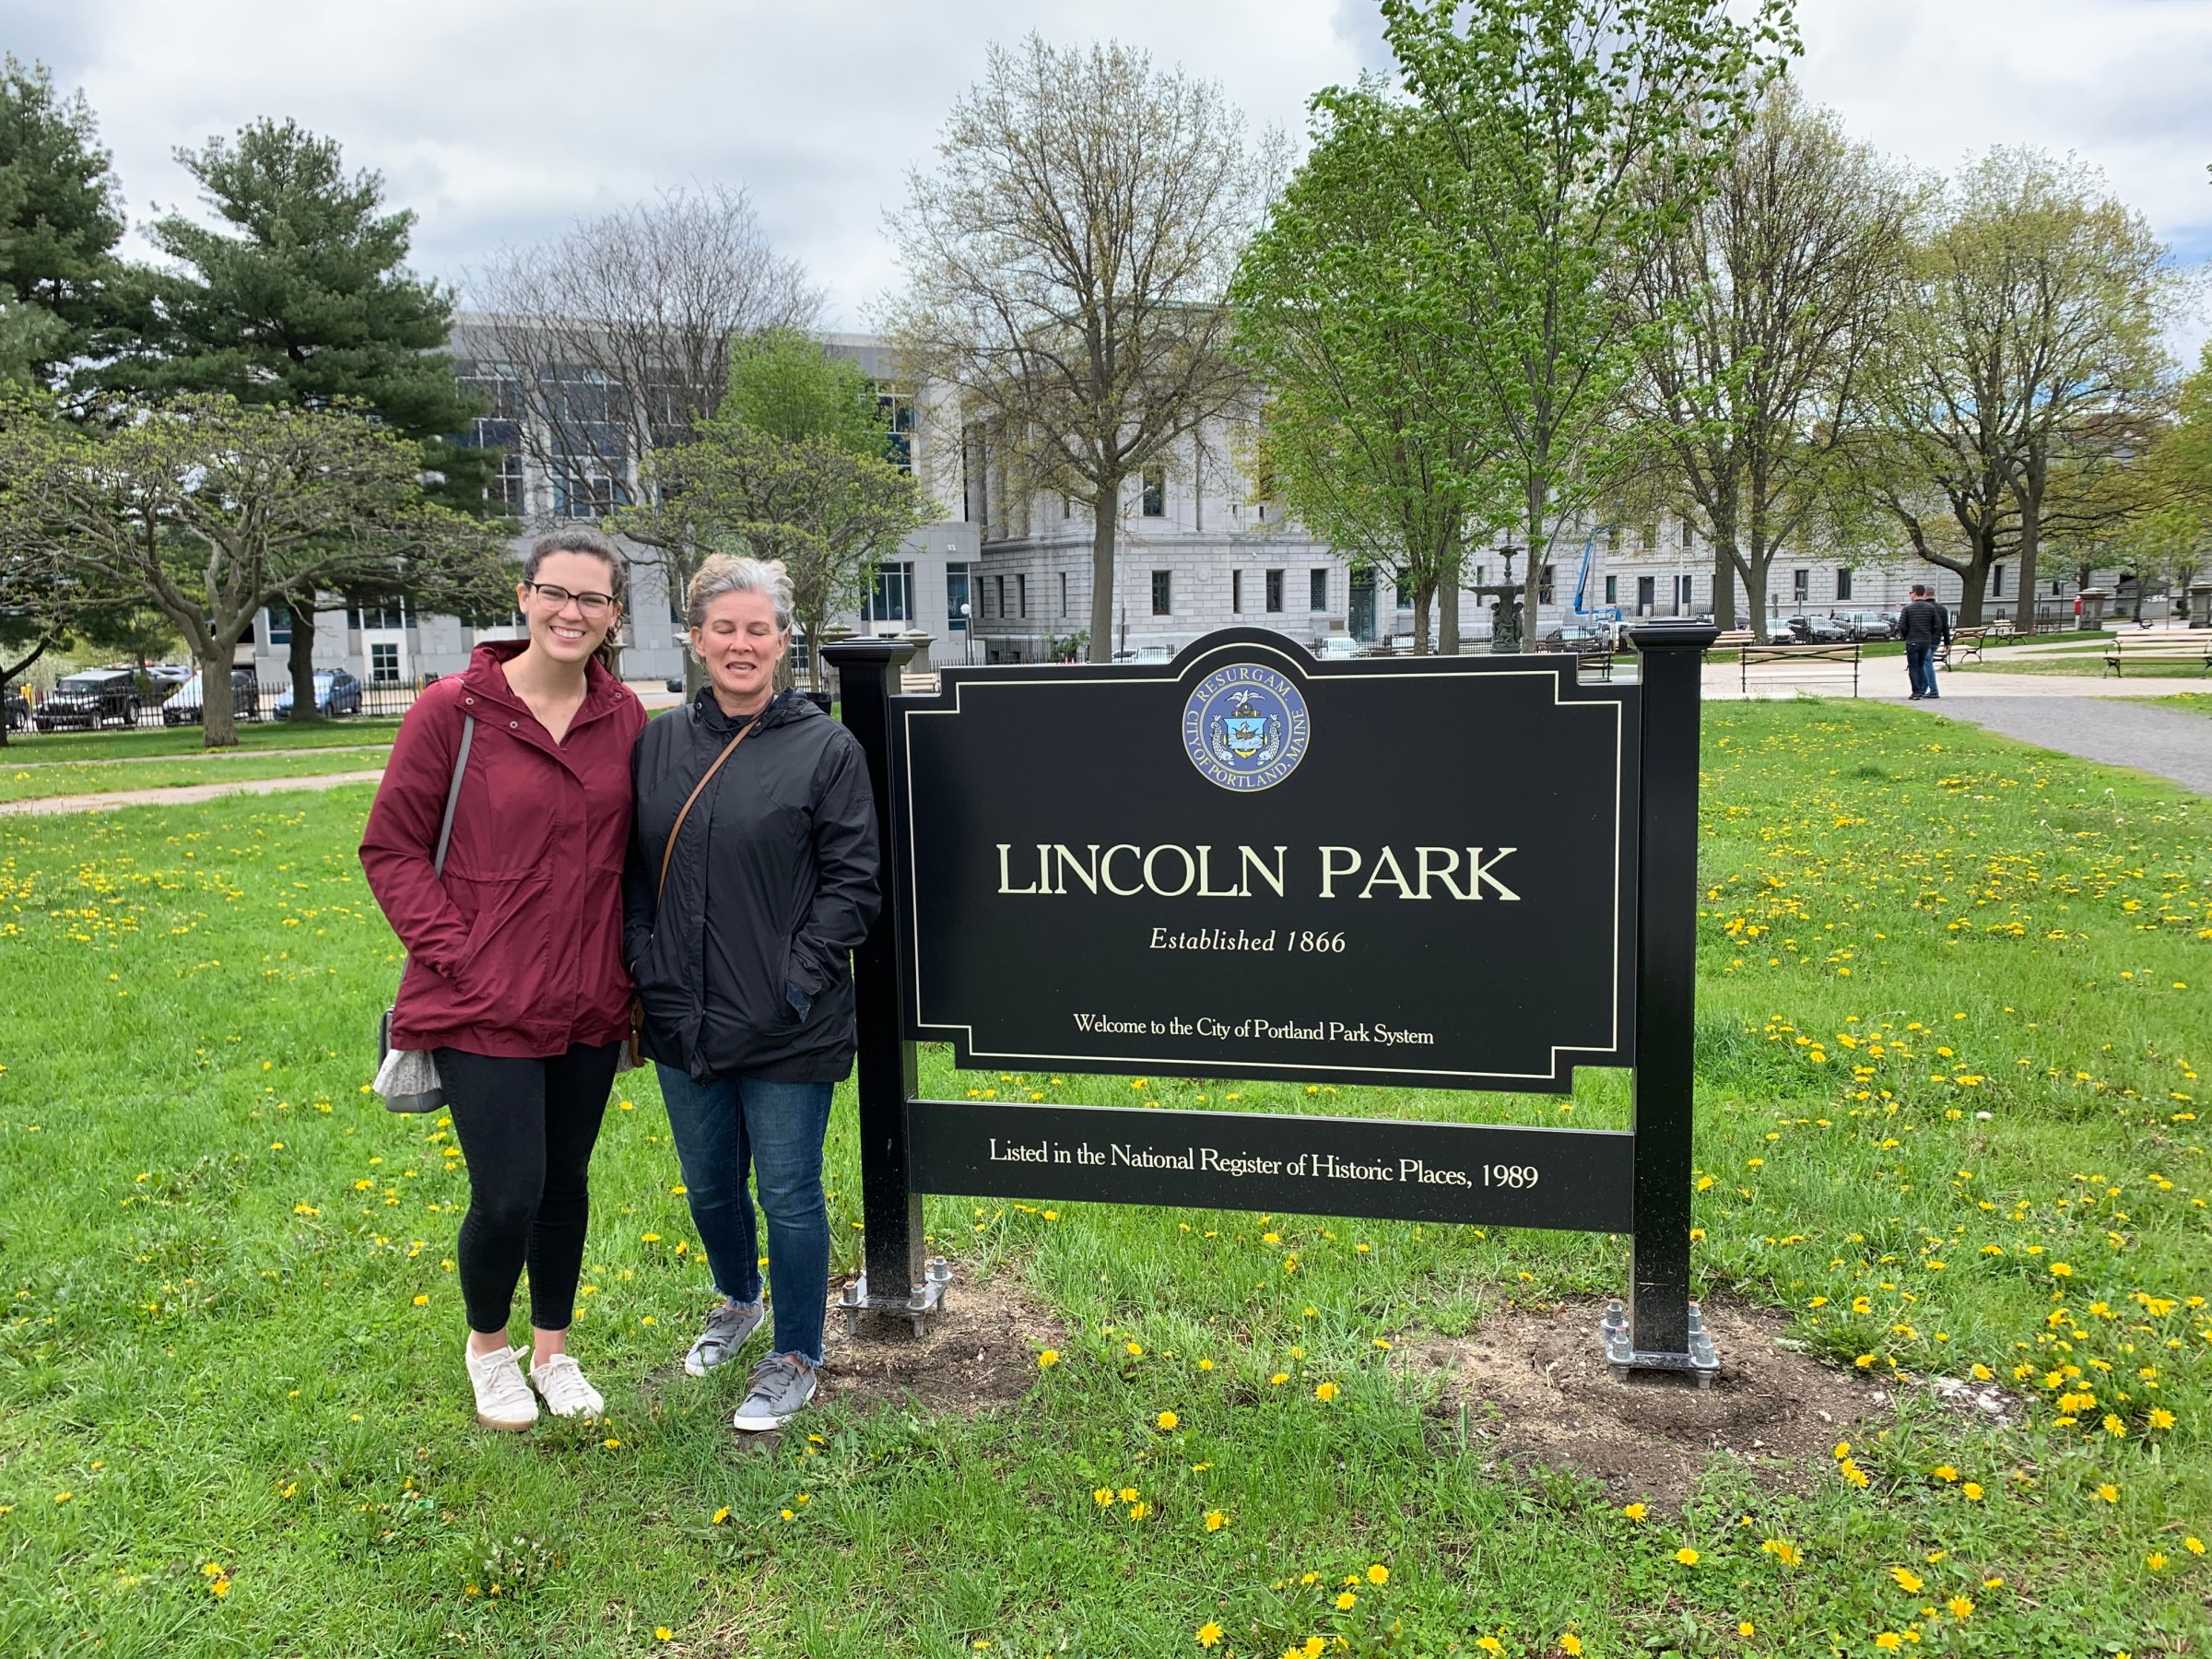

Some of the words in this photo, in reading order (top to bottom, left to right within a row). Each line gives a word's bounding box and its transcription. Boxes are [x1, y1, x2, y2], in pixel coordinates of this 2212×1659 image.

[1186, 710, 1201, 746] CITY
[1286, 708, 1306, 761] MAINE
[1193, 747, 1212, 766] OF
[1208, 761, 1291, 788] PORTLAND,
[996, 842, 1288, 899] LINCOLN
[1318, 844, 1522, 903] PARK
[1148, 927, 1277, 951] Established
[1288, 930, 1346, 954] 1866
[1072, 1013, 1147, 1035] Welcome
[1150, 1018, 1166, 1035] to
[1169, 1017, 1194, 1036] the
[1196, 1017, 1231, 1041] City
[1234, 1019, 1252, 1039] of
[1254, 1019, 1325, 1041] Portland
[1328, 1021, 1371, 1042] Park
[1373, 1023, 1435, 1047] System
[989, 1138, 1049, 1163] Listed
[1053, 1142, 1072, 1164] in
[1077, 1142, 1106, 1166] the
[1110, 1143, 1195, 1171] National
[1199, 1147, 1283, 1177] Register
[1286, 1153, 1309, 1176] of
[1311, 1153, 1394, 1182] Historic
[1398, 1159, 1473, 1189] Places,
[1482, 1164, 1539, 1189] 1989
